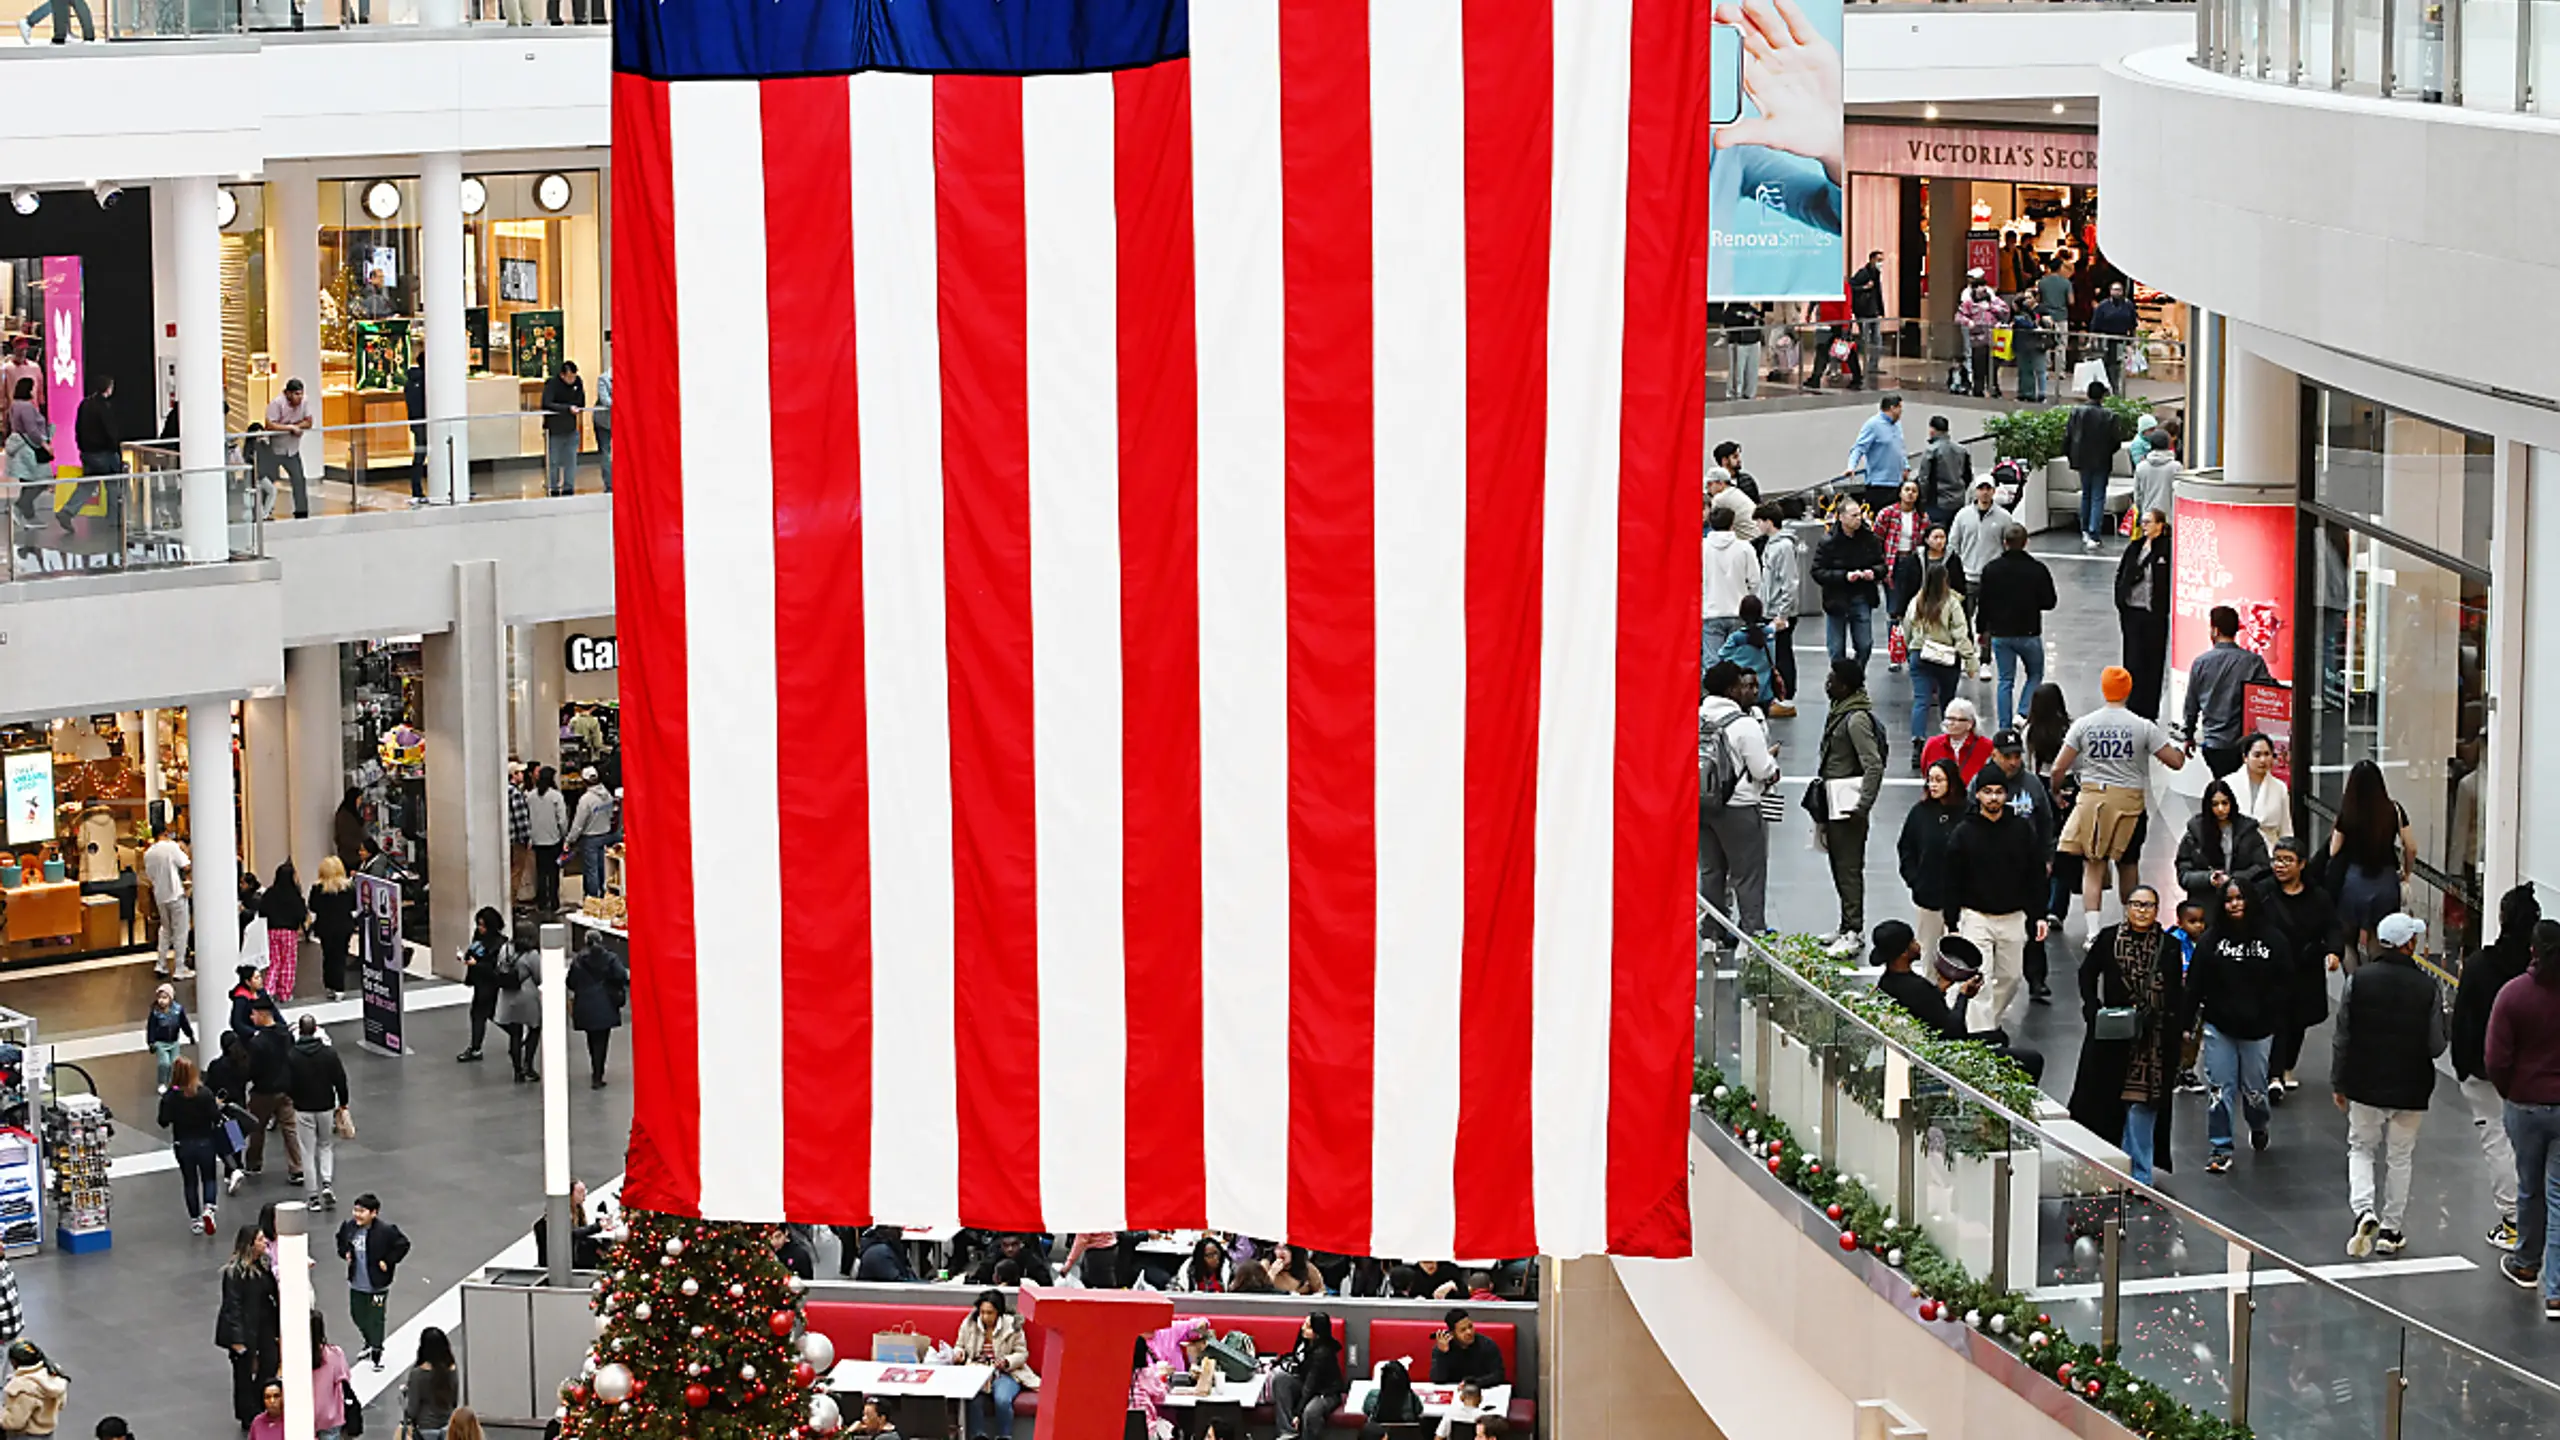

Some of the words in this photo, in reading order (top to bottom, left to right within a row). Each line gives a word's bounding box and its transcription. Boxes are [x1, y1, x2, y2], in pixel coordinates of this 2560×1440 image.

[1907, 140, 2034, 168] VICTORIA'S
[2209, 570, 2233, 588] UP
[571, 637, 619, 671] Ga
[2088, 740, 2135, 758] 2024
